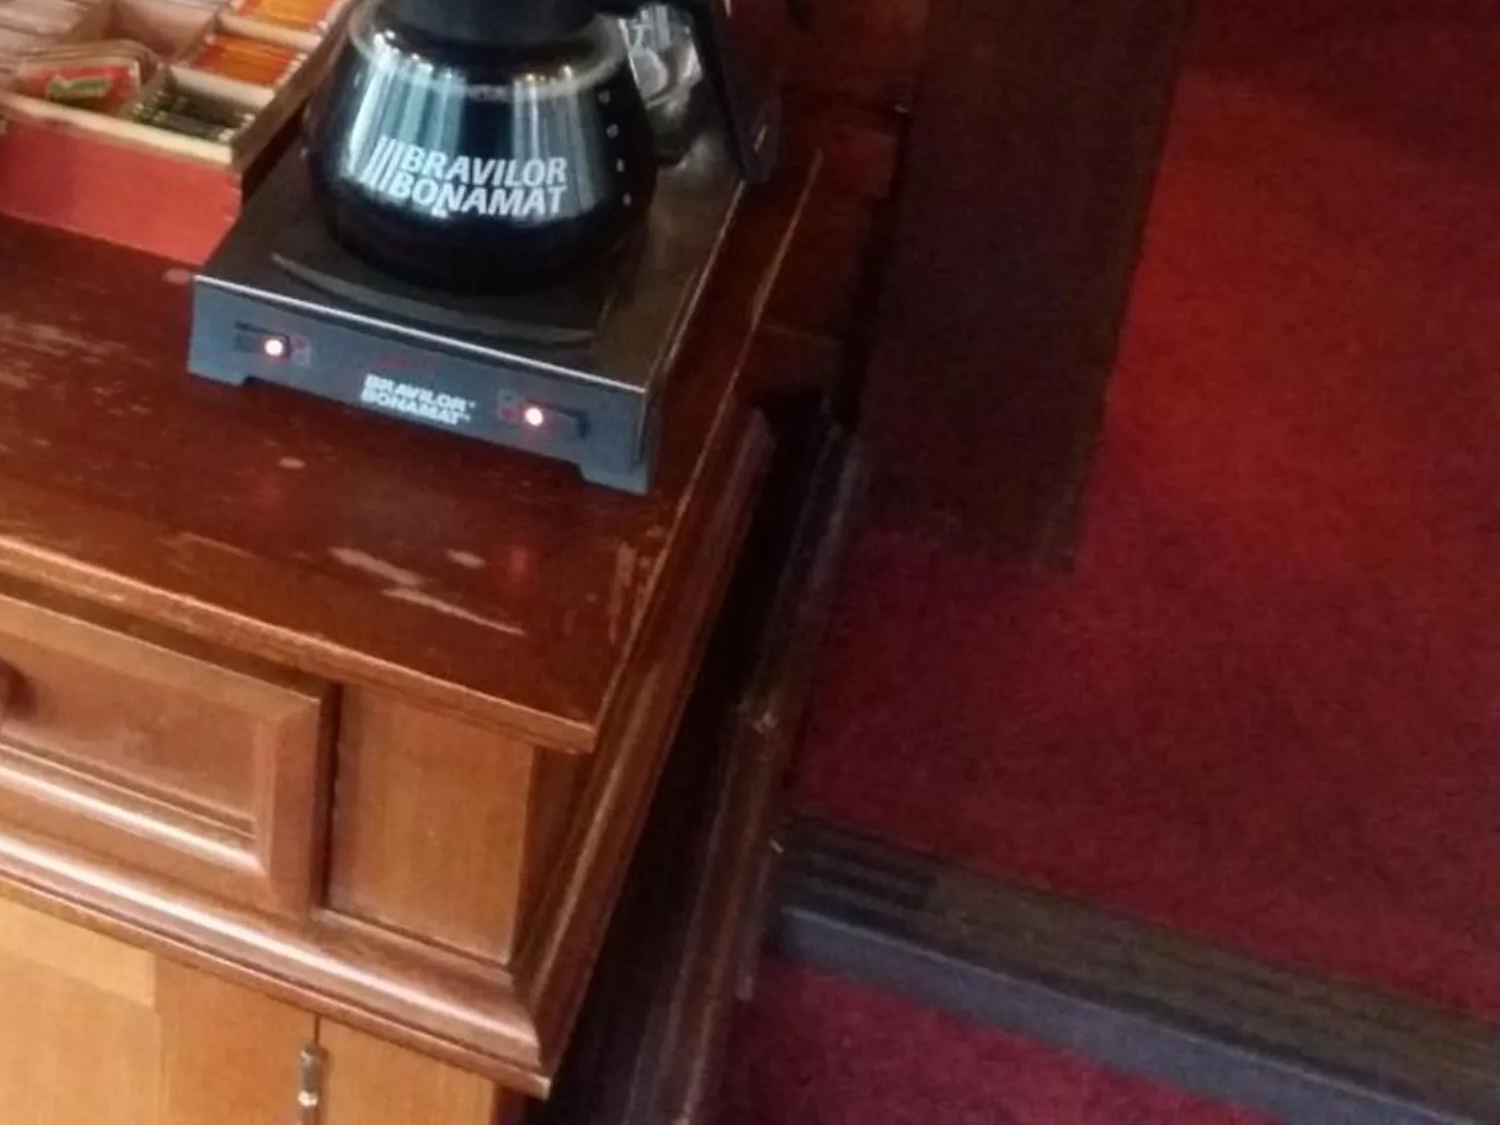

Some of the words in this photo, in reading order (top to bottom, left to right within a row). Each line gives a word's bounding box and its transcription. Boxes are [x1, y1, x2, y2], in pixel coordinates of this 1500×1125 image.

[400, 144, 567, 187] BRAVILOR
[388, 174, 567, 216] BONAMAT
[360, 388, 461, 425] BONAMAT
[363, 373, 467, 412] BRAVILOR
